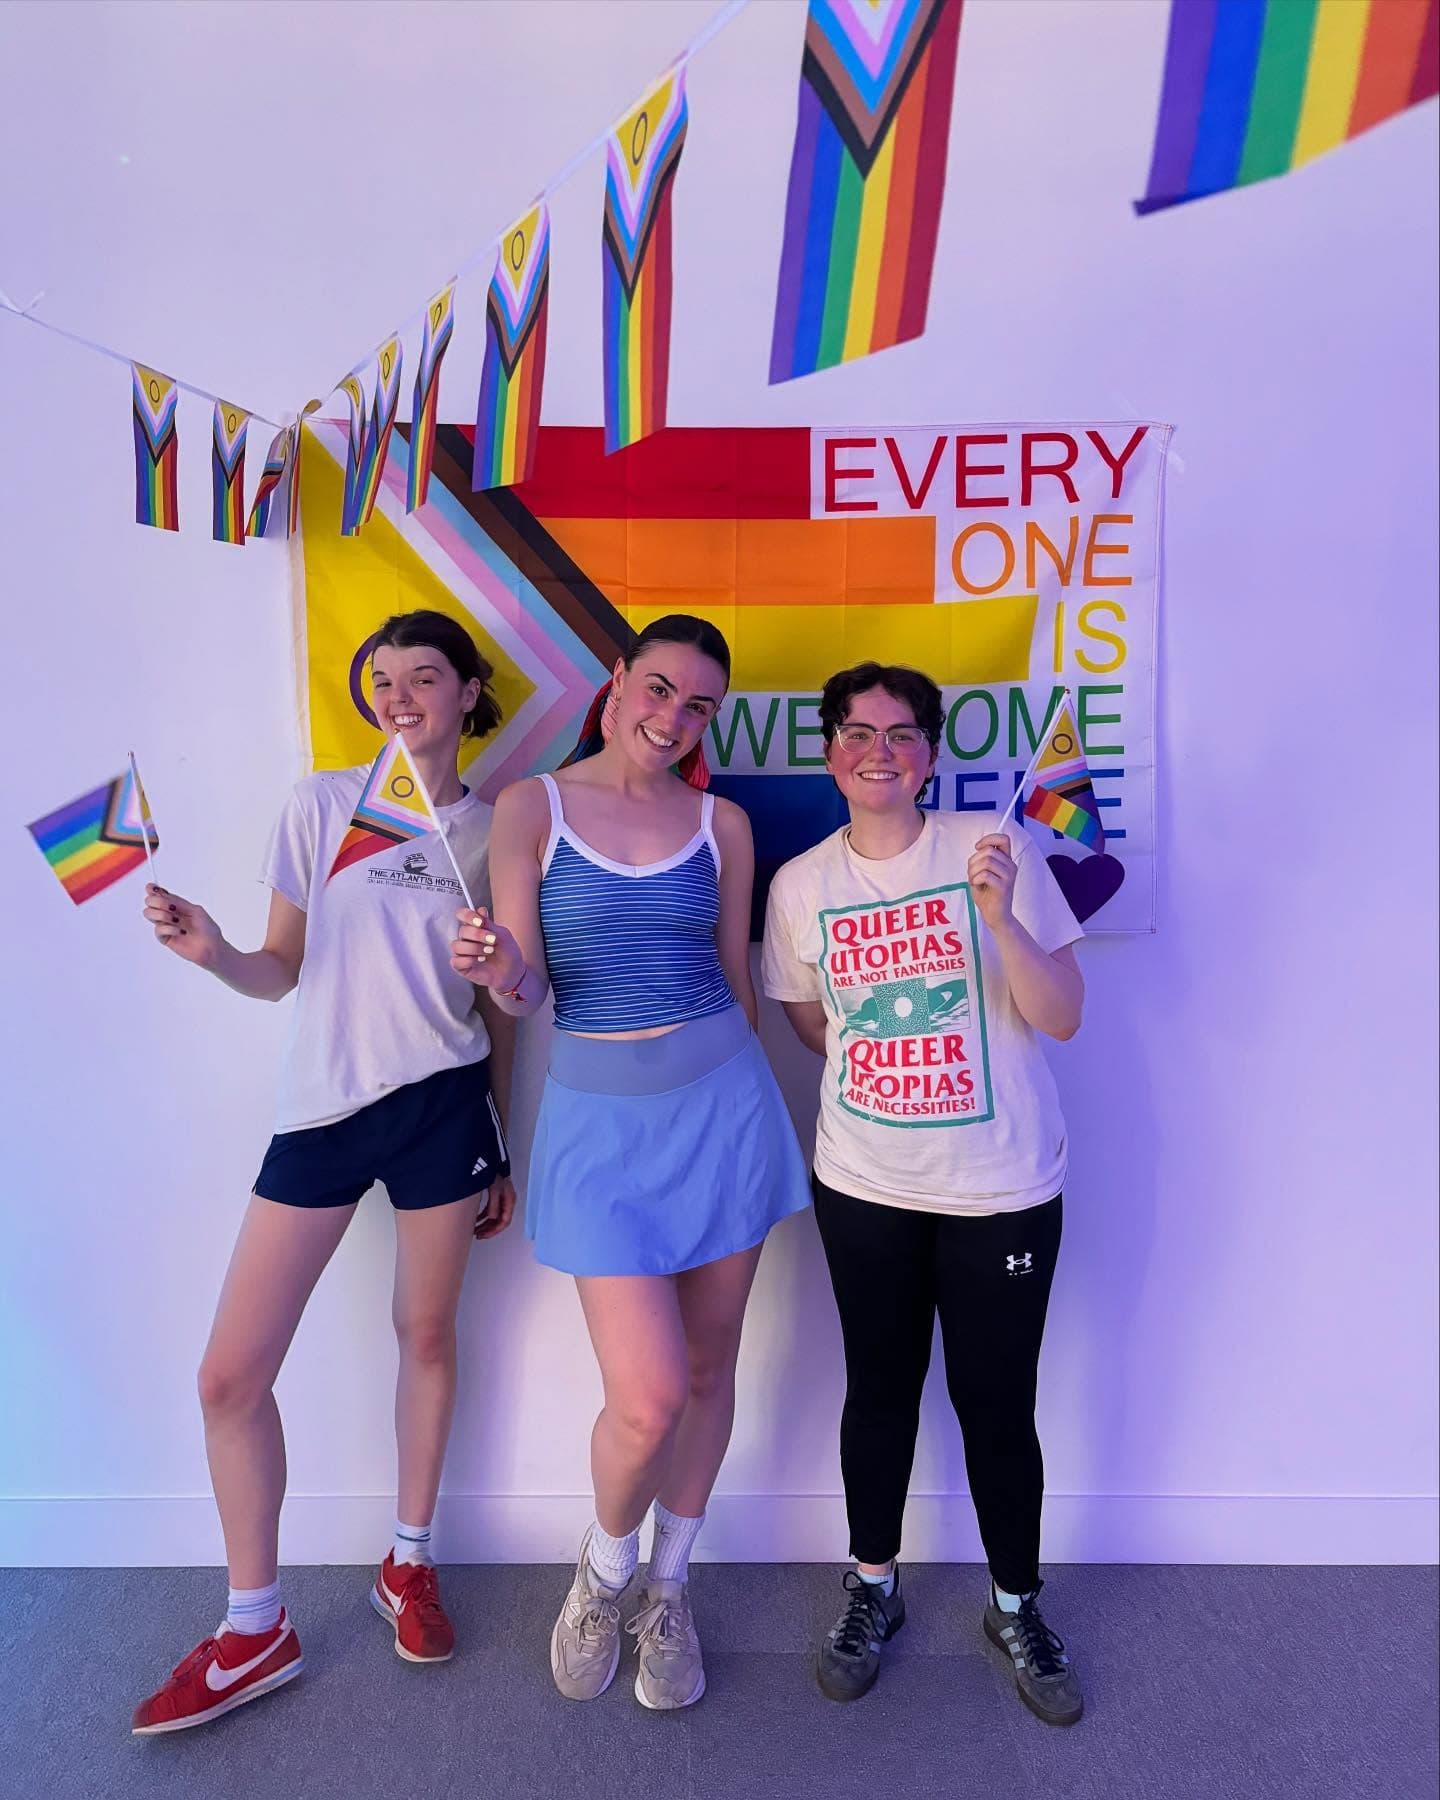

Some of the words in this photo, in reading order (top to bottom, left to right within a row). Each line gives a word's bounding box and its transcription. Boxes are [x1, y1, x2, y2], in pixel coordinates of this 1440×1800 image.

[823, 426, 1149, 512] EVERY
[951, 514, 1133, 596] ONE
[1053, 600, 1127, 674] IS
[710, 684, 1125, 768] WEOME
[369, 869, 388, 878] THE
[390, 871, 433, 886] ATLANTIS
[832, 899, 951, 947] QUEER
[830, 931, 963, 975] UTOPIAS
[833, 975, 856, 988] ARE
[860, 970, 888, 985] NOT
[893, 957, 966, 979] FANTASIES
[848, 1034, 968, 1072] QUEER
[845, 1087, 870, 1107] ARE
[872, 1097, 976, 1116] NECESSITIES!
